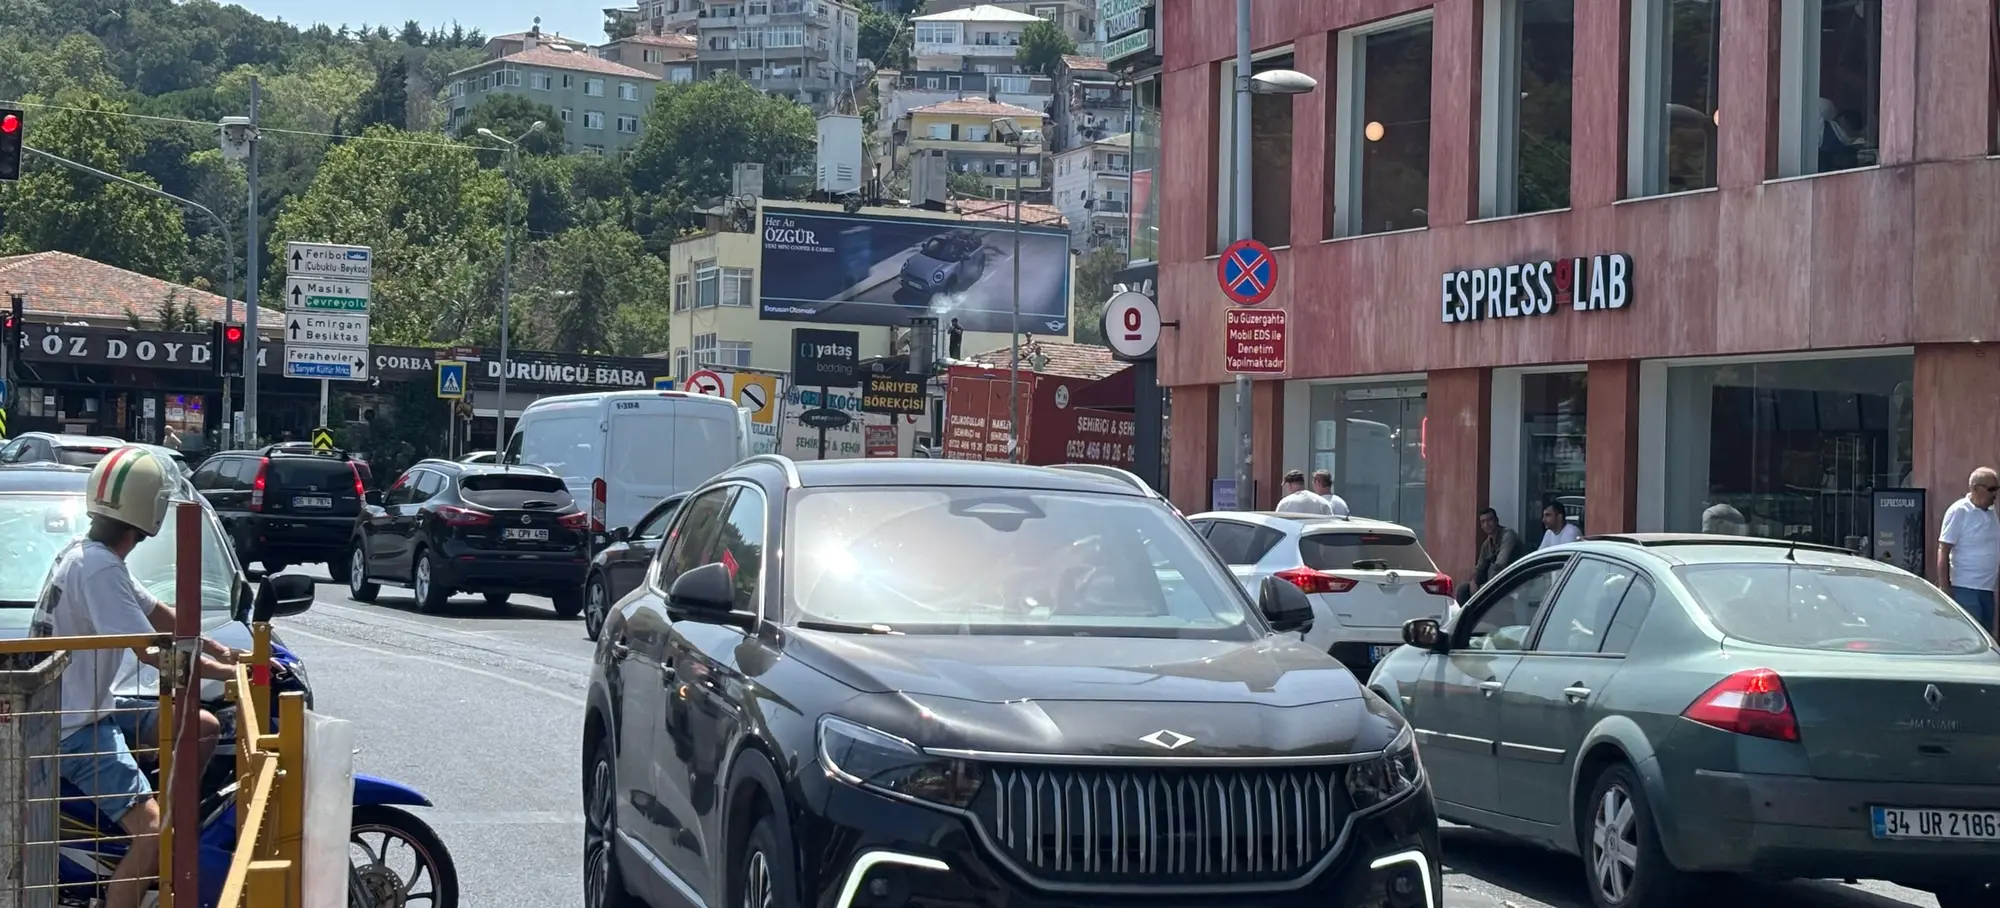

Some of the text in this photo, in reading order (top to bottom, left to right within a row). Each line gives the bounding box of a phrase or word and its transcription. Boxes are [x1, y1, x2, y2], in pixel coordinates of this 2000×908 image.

[765, 217, 795, 228] Her An
[765, 227, 819, 245] ÖZGÜR.
[305, 249, 347, 260] Feribot
[307, 283, 352, 294] Maslak
[764, 305, 789, 314] Borusan
[306, 318, 361, 330] Emirgan
[1228, 312, 1285, 326] Bu Güzergahta
[306, 330, 359, 343] Beşiktaş
[1229, 329, 1282, 340] Mobil EDS ile
[42, 326, 88, 357] ÖZ
[816, 343, 853, 360] yataş
[1237, 343, 1274, 354] Denetim
[290, 350, 354, 361] Ferahevler
[376, 355, 433, 371] ÇORBA
[816, 363, 853, 375] bedding
[1227, 357, 1284, 369] Yapılmaktadır
[488, 359, 647, 386] DÜRÜMCÜ BABA
[871, 380, 918, 393] SARIYER
[863, 395, 924, 410] BÖREKÇİSİ
[1111, 420, 1117, 434] &
[1118, 421, 1135, 437] ŞEHİ
[1066, 440, 1085, 458] 0532
[1103, 442, 1111, 460] 19
[1886, 810, 1997, 837] 34 UR 2186
